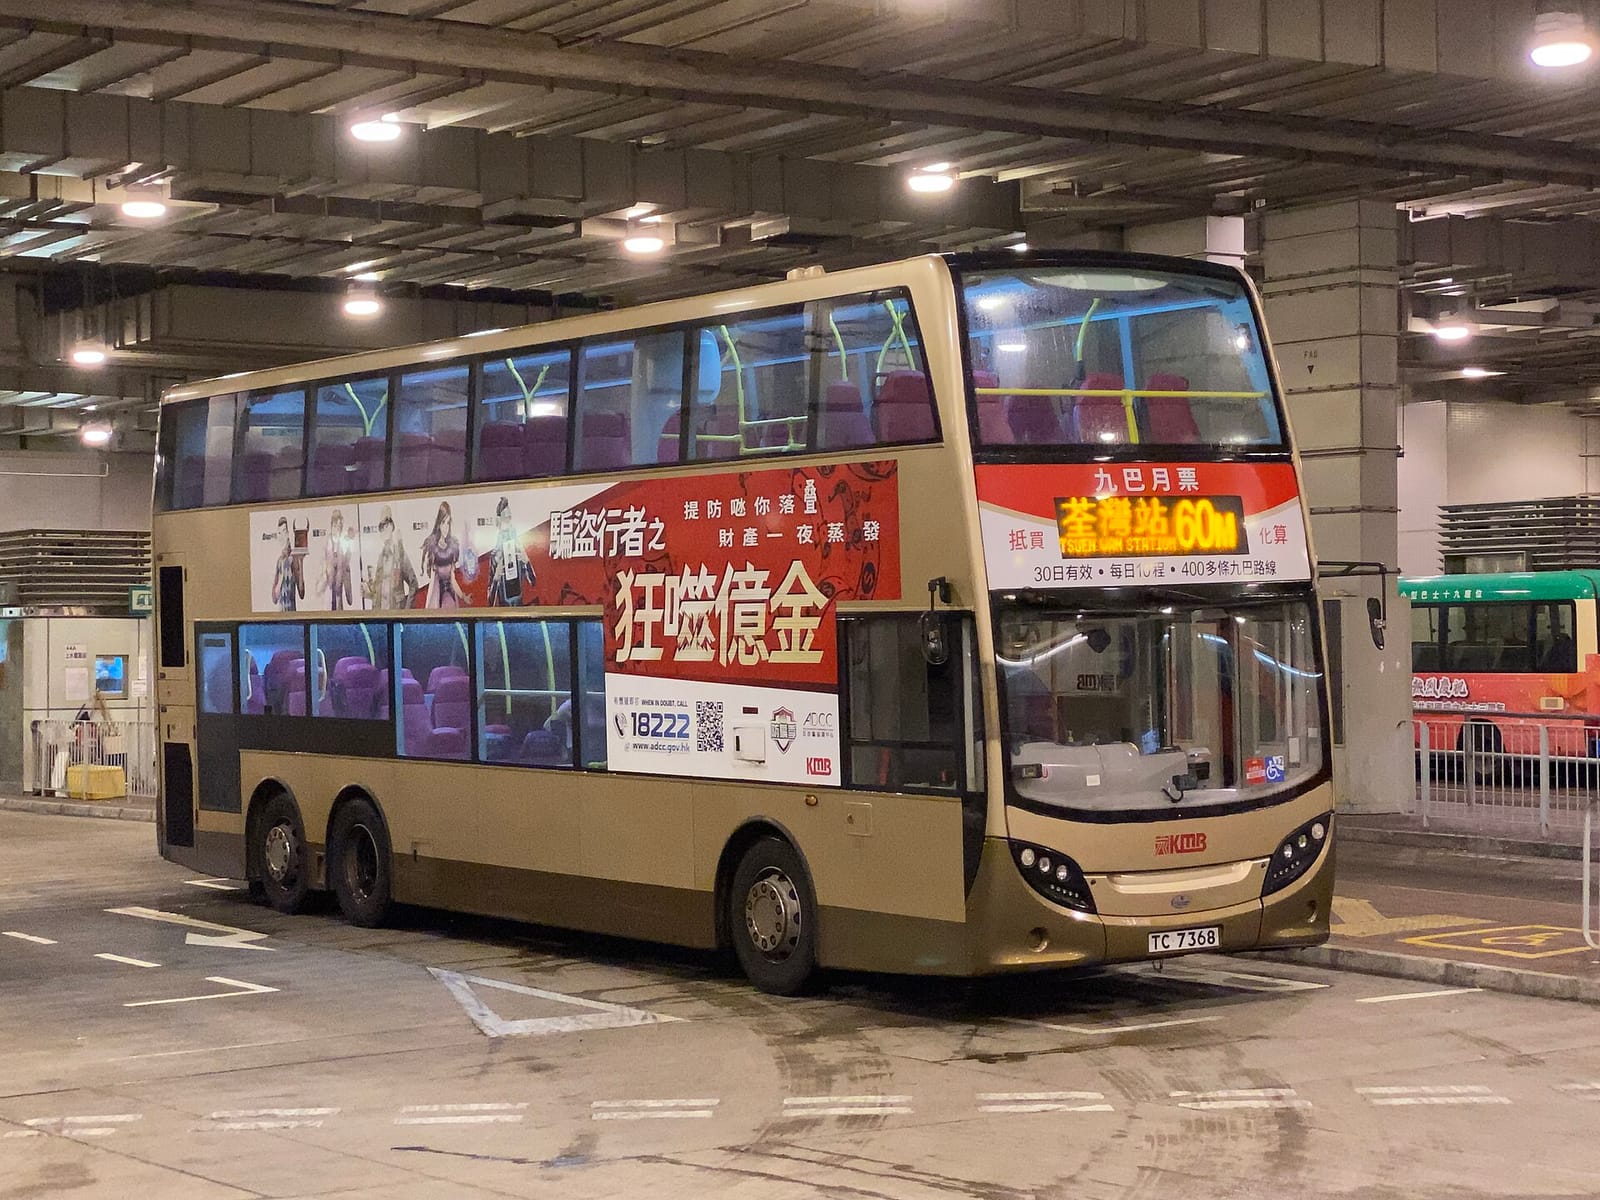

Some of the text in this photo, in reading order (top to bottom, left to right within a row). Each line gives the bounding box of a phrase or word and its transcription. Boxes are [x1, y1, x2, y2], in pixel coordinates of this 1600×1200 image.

[1095, 467, 1199, 492] 九巴月票
[1061, 496, 1168, 536] 荃灣站
[1176, 498, 1238, 549] 60M
[549, 505, 665, 560] 騙盜行者之
[719, 520, 880, 548] 財產一夜蒸發
[1009, 529, 1045, 551] 抵買
[1259, 525, 1288, 545] 化算
[1034, 564, 1092, 582] 30日有效
[1181, 560, 1277, 577] 400多條九巴路線
[614, 560, 829, 668] 狂噬億金
[631, 712, 690, 738] 18222
[803, 712, 832, 727] ADCC
[632, 742, 690, 753] www.adcc.gov.hk
[806, 757, 832, 776] KMB
[1169, 832, 1207, 854] KMB
[1151, 930, 1216, 950] TC 7368
